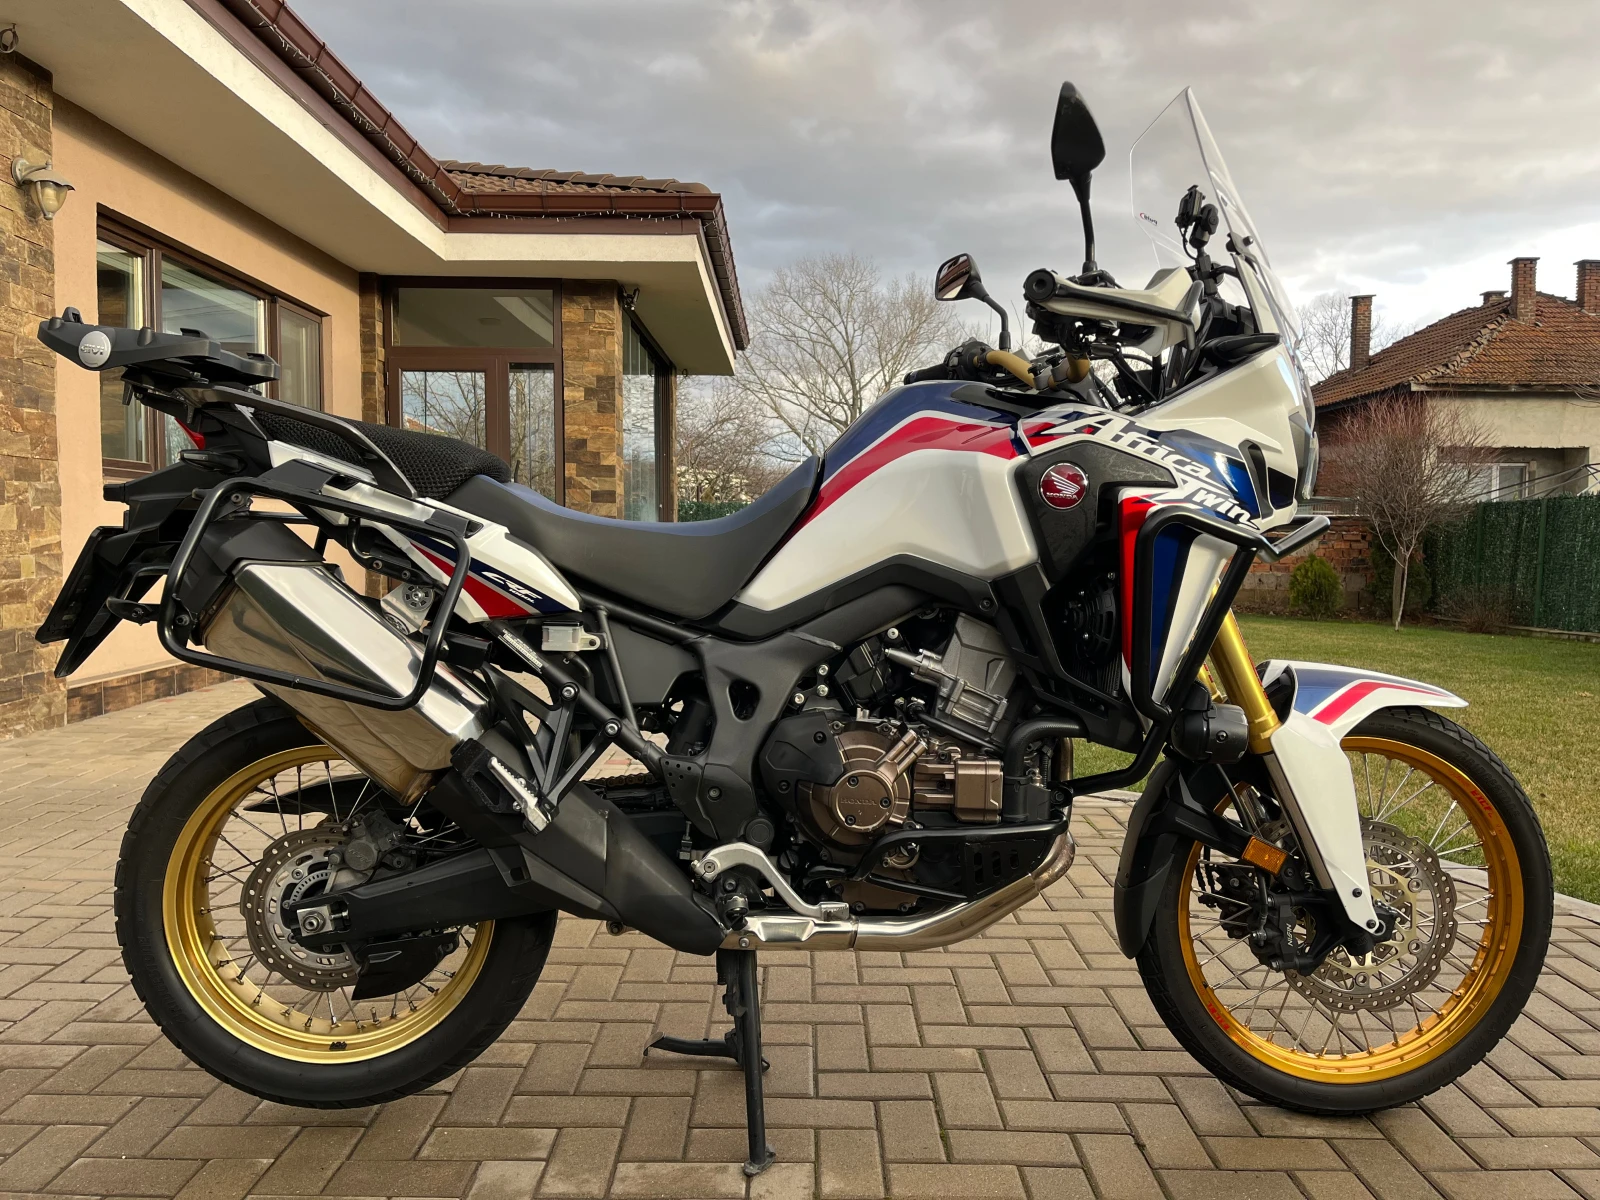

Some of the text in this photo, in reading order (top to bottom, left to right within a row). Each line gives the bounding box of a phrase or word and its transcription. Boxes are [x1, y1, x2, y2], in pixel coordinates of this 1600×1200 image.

[80, 343, 105, 355] GIVI
[1041, 414, 1228, 492] Africa
[1046, 491, 1079, 500] HONDA
[1151, 466, 1260, 530] Twin
[481, 571, 543, 599] CRF
[840, 797, 877, 806] HONDA
[1470, 789, 1493, 818] EXCEL
